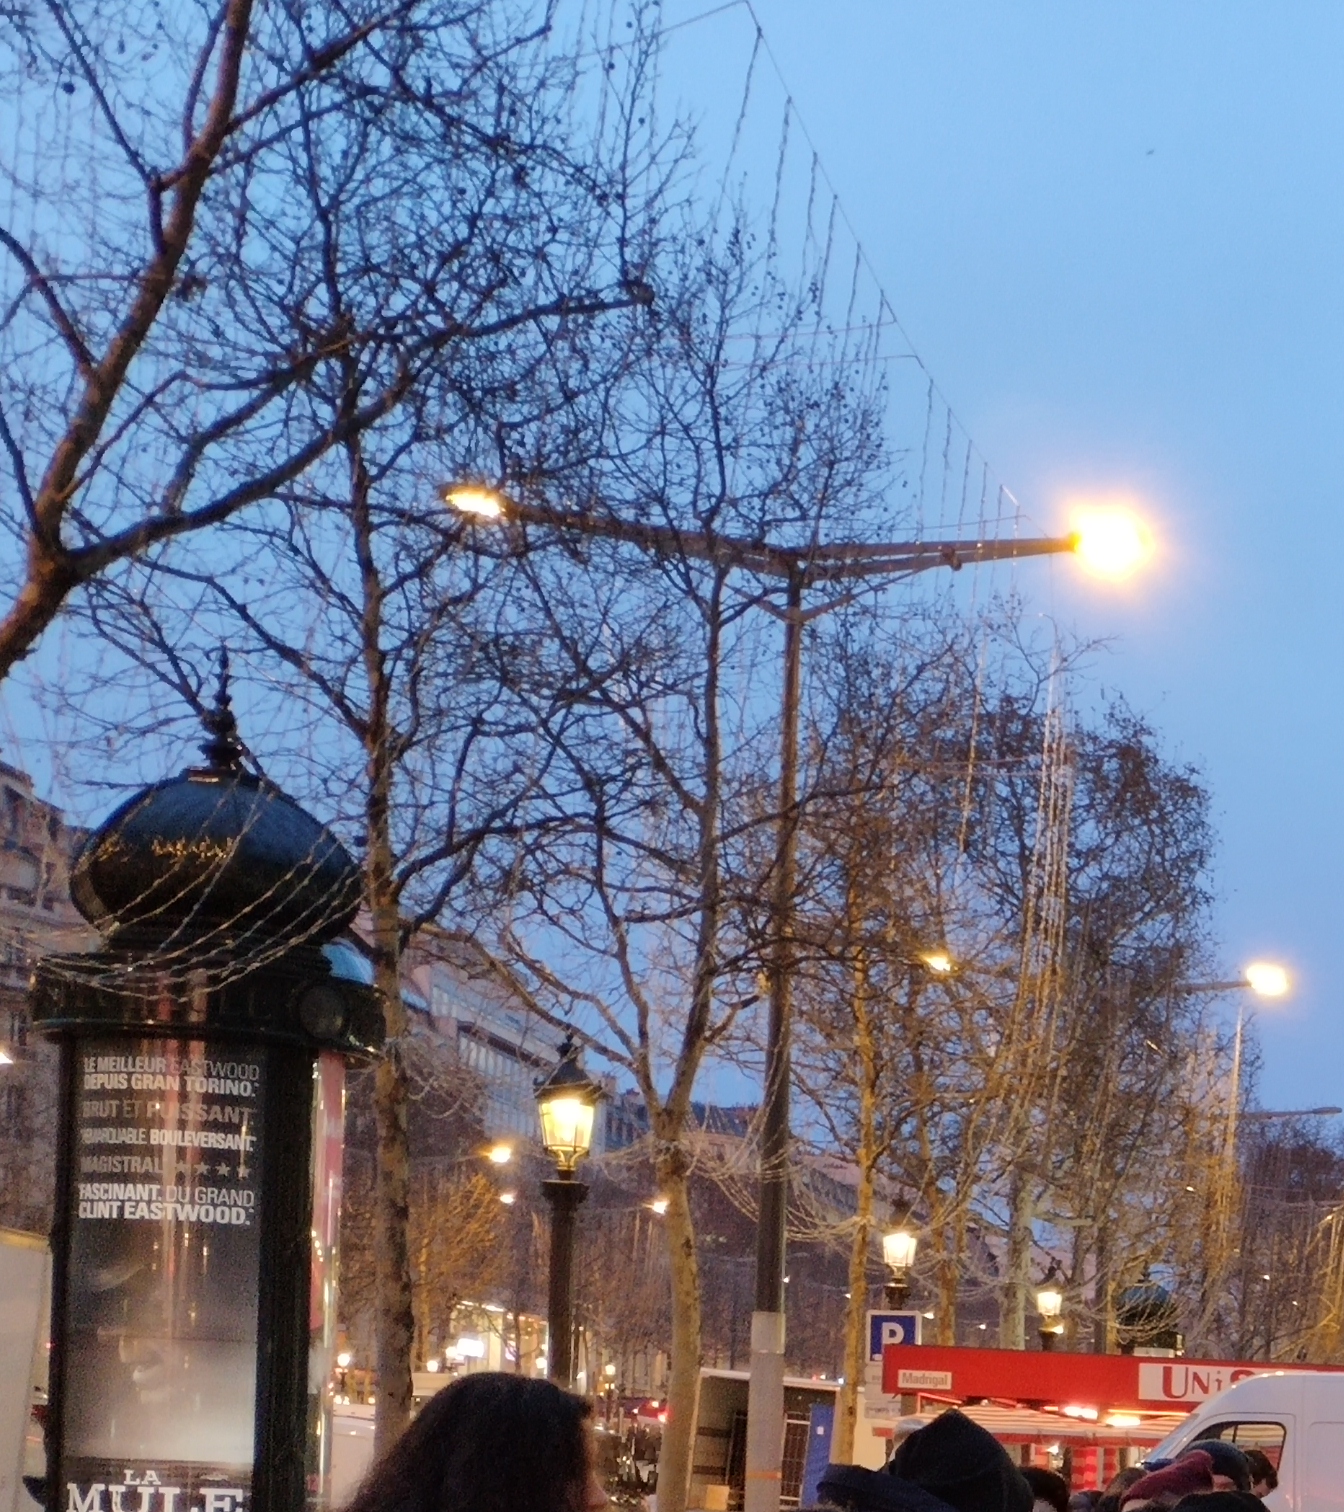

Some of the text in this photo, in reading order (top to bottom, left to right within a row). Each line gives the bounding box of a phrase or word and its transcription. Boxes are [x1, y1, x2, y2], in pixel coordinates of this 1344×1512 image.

[97, 1056, 167, 1073] MEILLEUR
[170, 1058, 260, 1080] EASTWOOD
[84, 1073, 128, 1089] DEPUIS
[131, 1073, 180, 1091] GRAN
[83, 1100, 120, 1118] BRUT
[123, 1100, 140, 1118] ET
[166, 1186, 190, 1203] DU
[195, 1186, 255, 1207] GRAND
[78, 1201, 121, 1218] CLINT
[881, 1322, 904, 1346] P
[901, 1372, 948, 1388] Madrigal
[123, 1469, 162, 1485] LA
